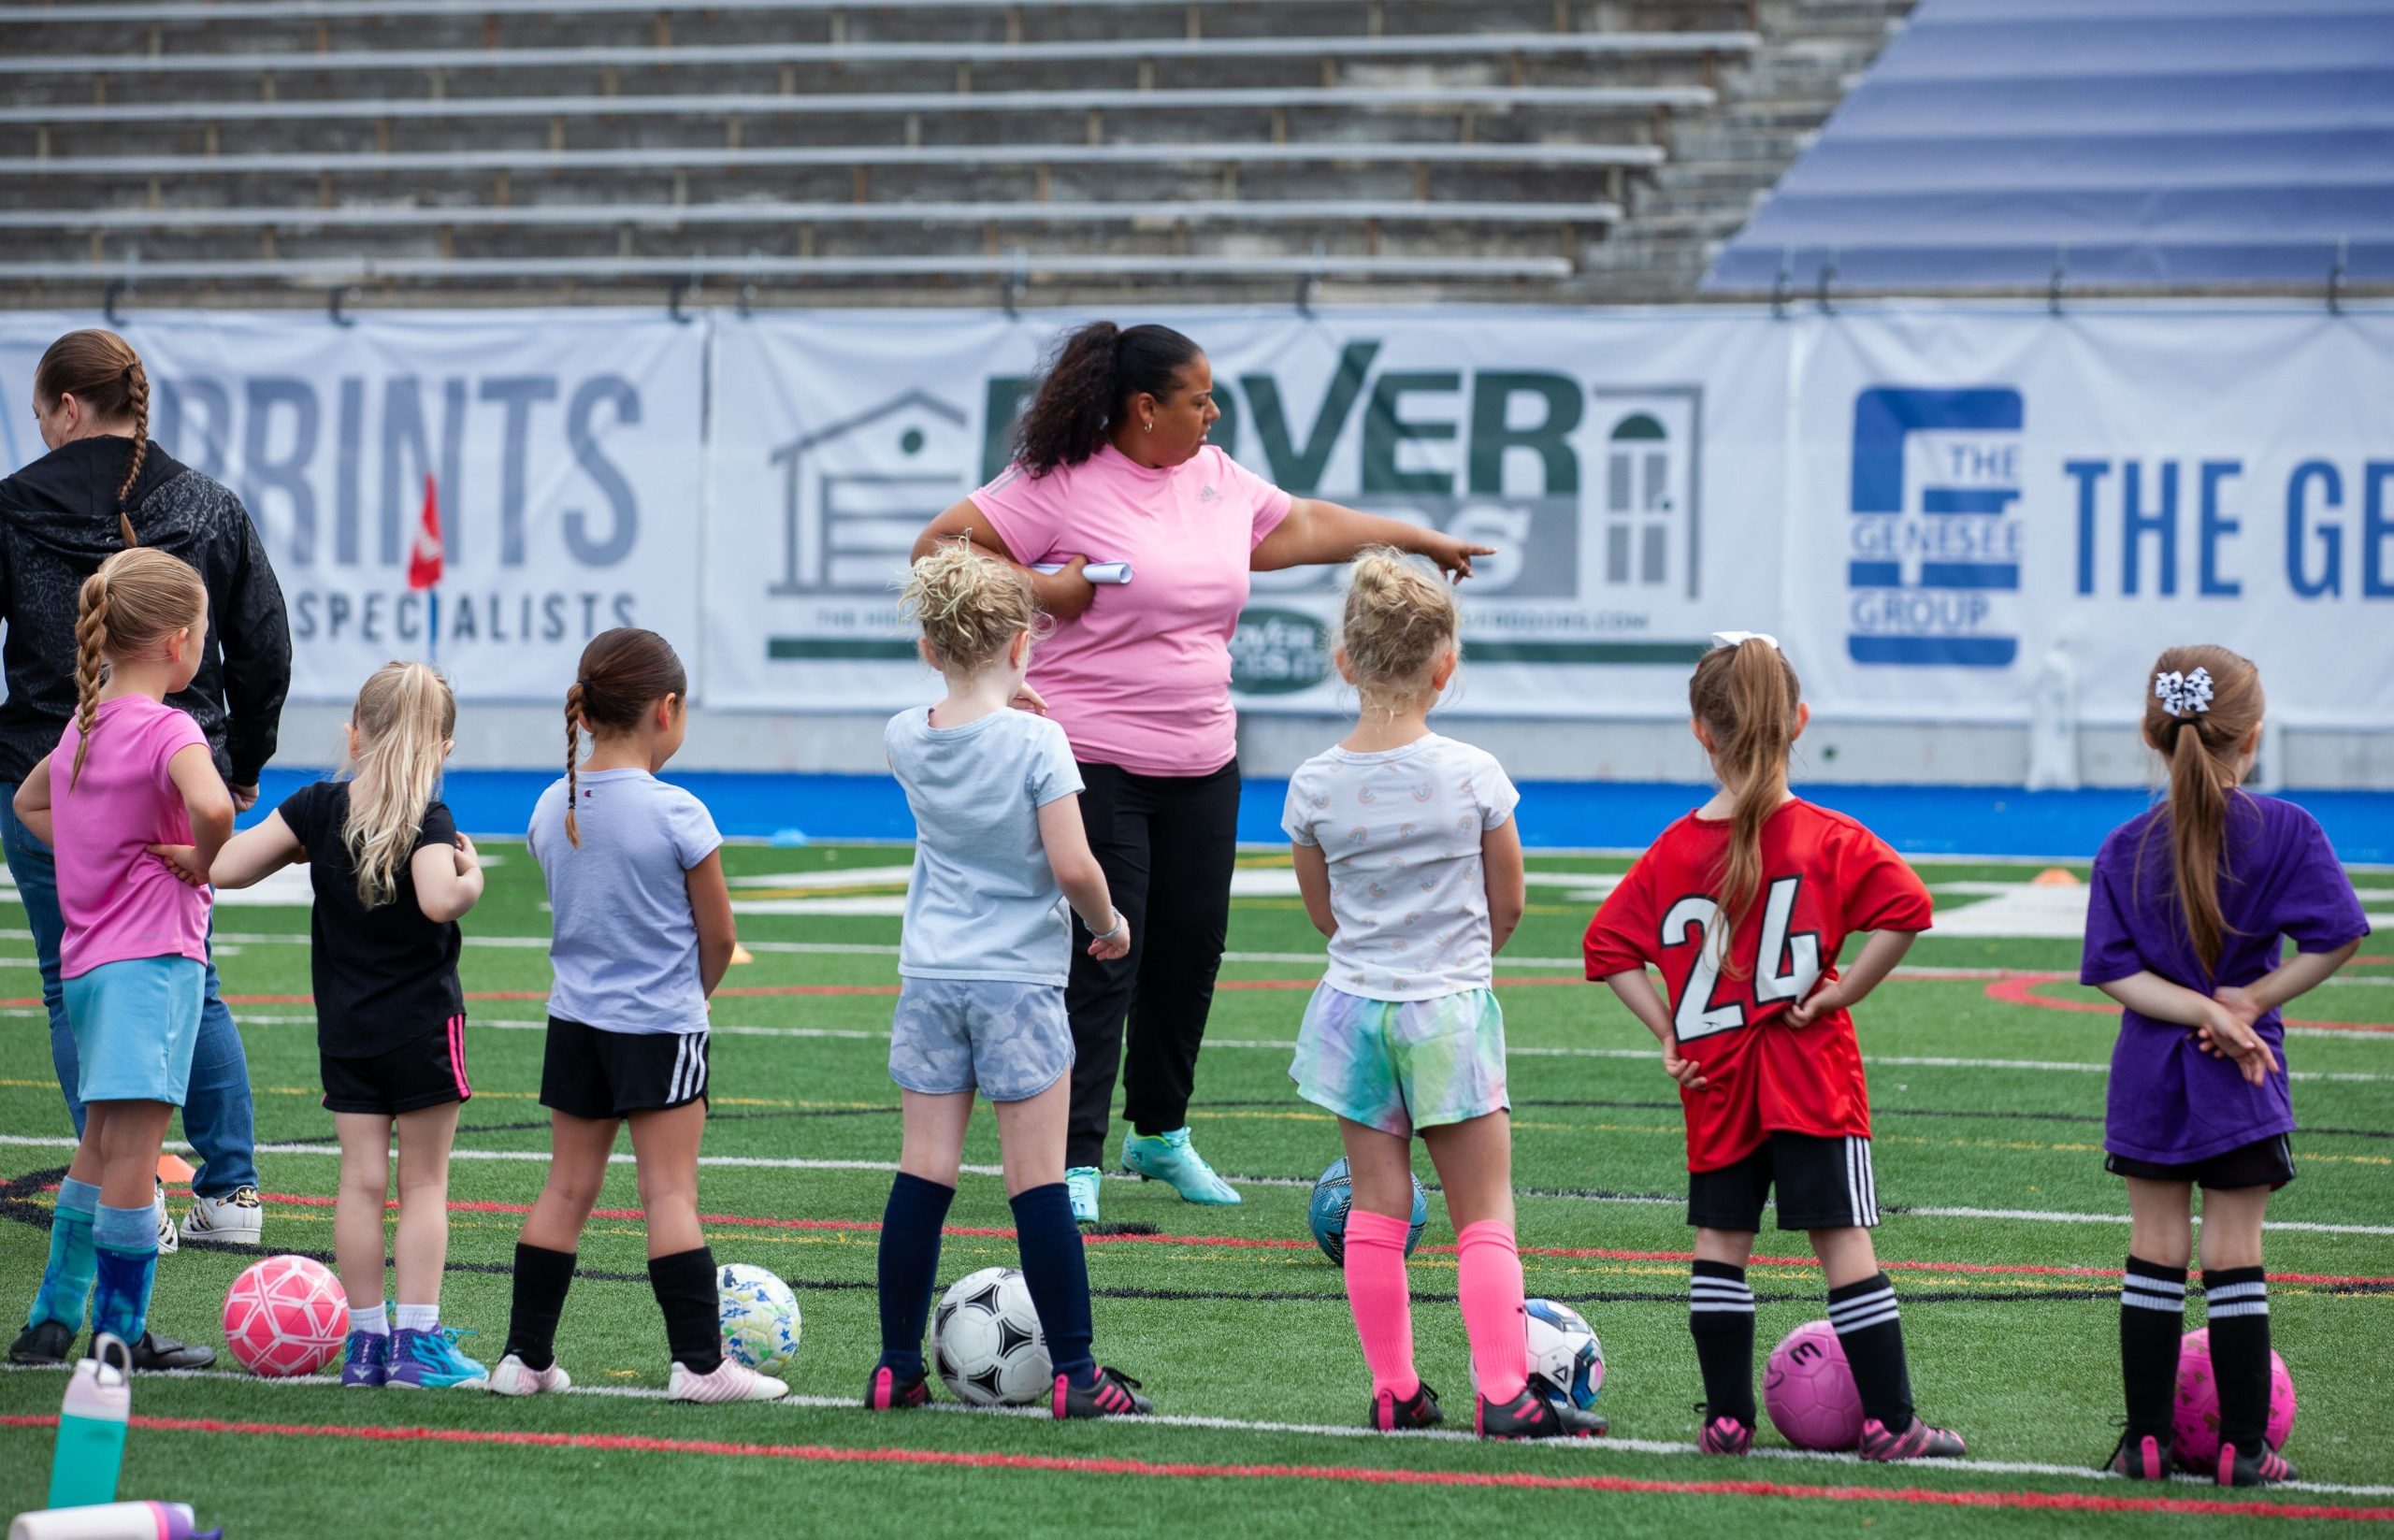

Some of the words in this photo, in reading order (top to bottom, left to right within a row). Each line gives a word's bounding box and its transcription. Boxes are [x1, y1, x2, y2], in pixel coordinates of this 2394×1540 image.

[1949, 443, 2021, 479] THE
[1851, 518, 2025, 557] GENESEE
[2063, 459, 2243, 597] THE
[2286, 460, 2394, 600] GE
[295, 591, 637, 642] SPECALISTS
[1850, 592, 1991, 631] GROUP
[1660, 873, 1823, 1043] 24
